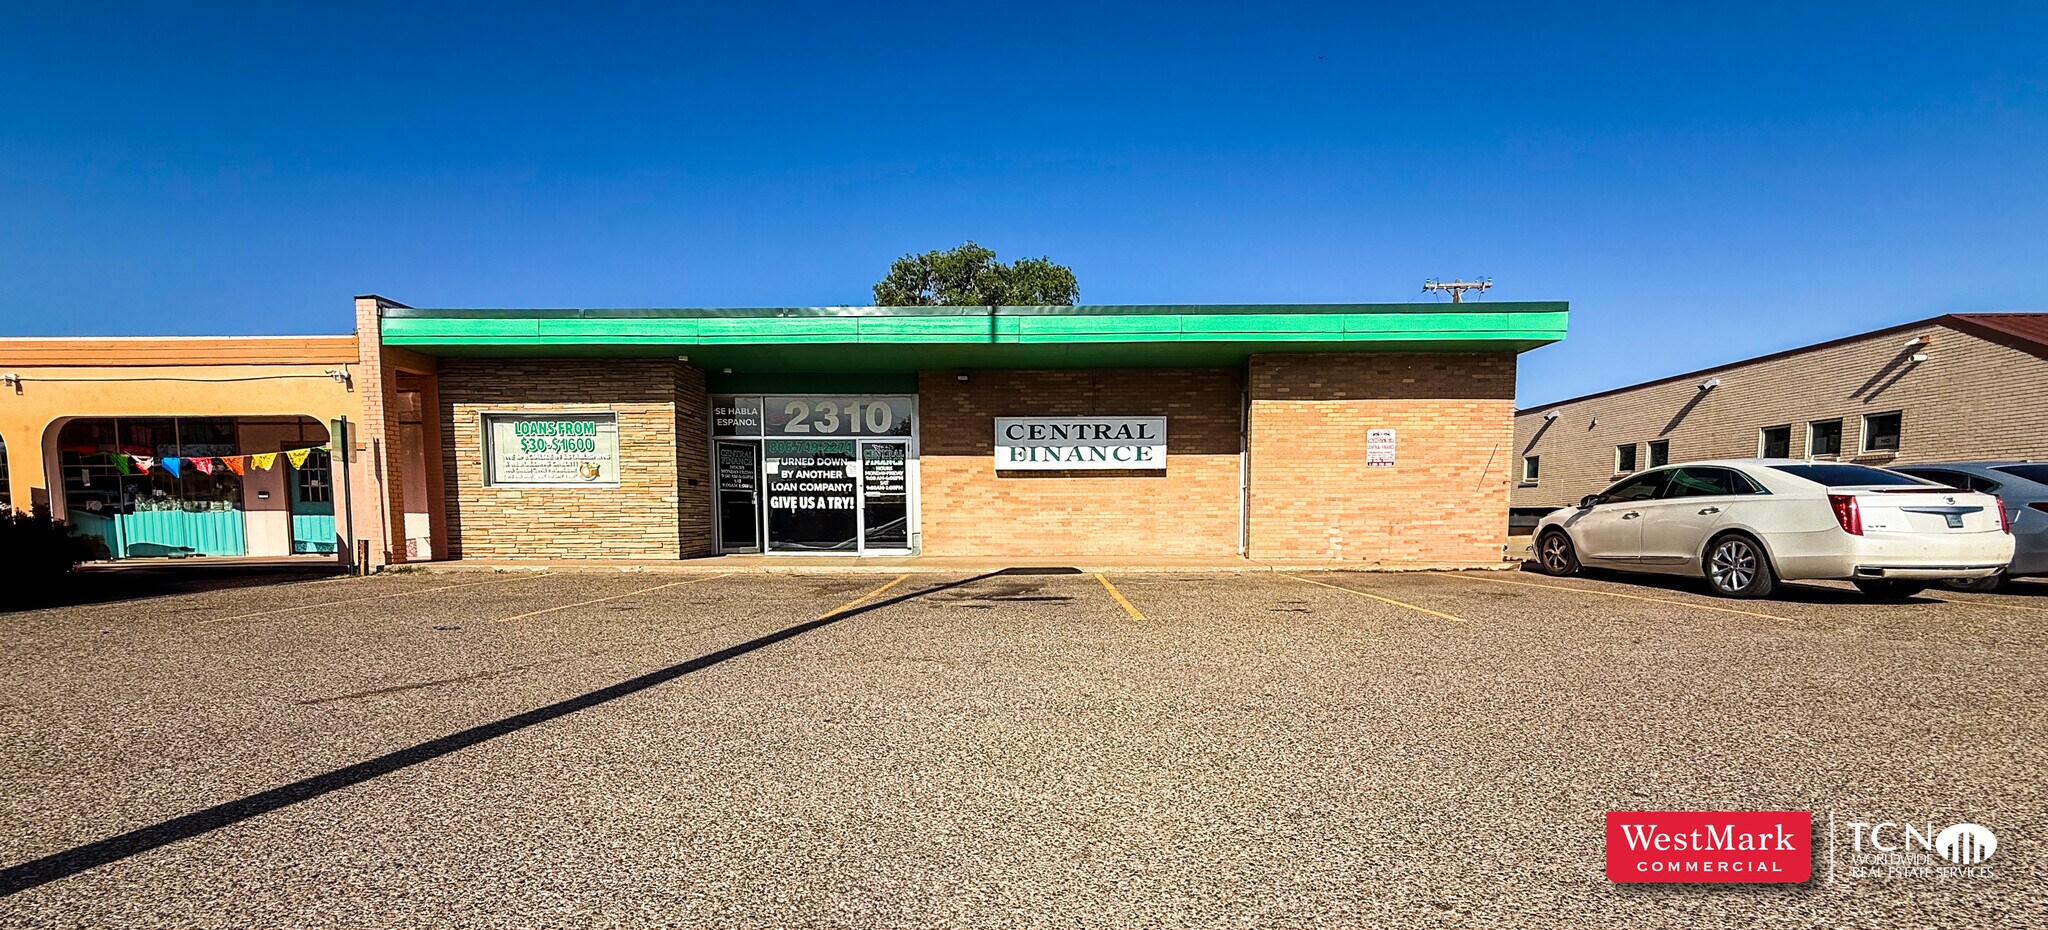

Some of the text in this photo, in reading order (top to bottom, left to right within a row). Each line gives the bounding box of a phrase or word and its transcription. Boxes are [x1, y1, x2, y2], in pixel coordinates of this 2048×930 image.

[715, 407, 758, 415] SE HABLA
[717, 418, 757, 426] ESPANOL
[784, 401, 893, 433] 2310
[514, 421, 596, 436] LOANS FROM
[1005, 423, 1156, 441] CENTRAL
[769, 440, 854, 455] 806-749-2274
[720, 448, 753, 459] CENTRAL
[1009, 445, 1154, 463] FINANCE
[720, 456, 753, 466] FINANCE
[816, 457, 848, 466] DOWN
[781, 470, 843, 479] BY ANOTHER
[771, 482, 853, 491] LOAN COMPANY?
[770, 496, 855, 509] GIVE US A TRY!
